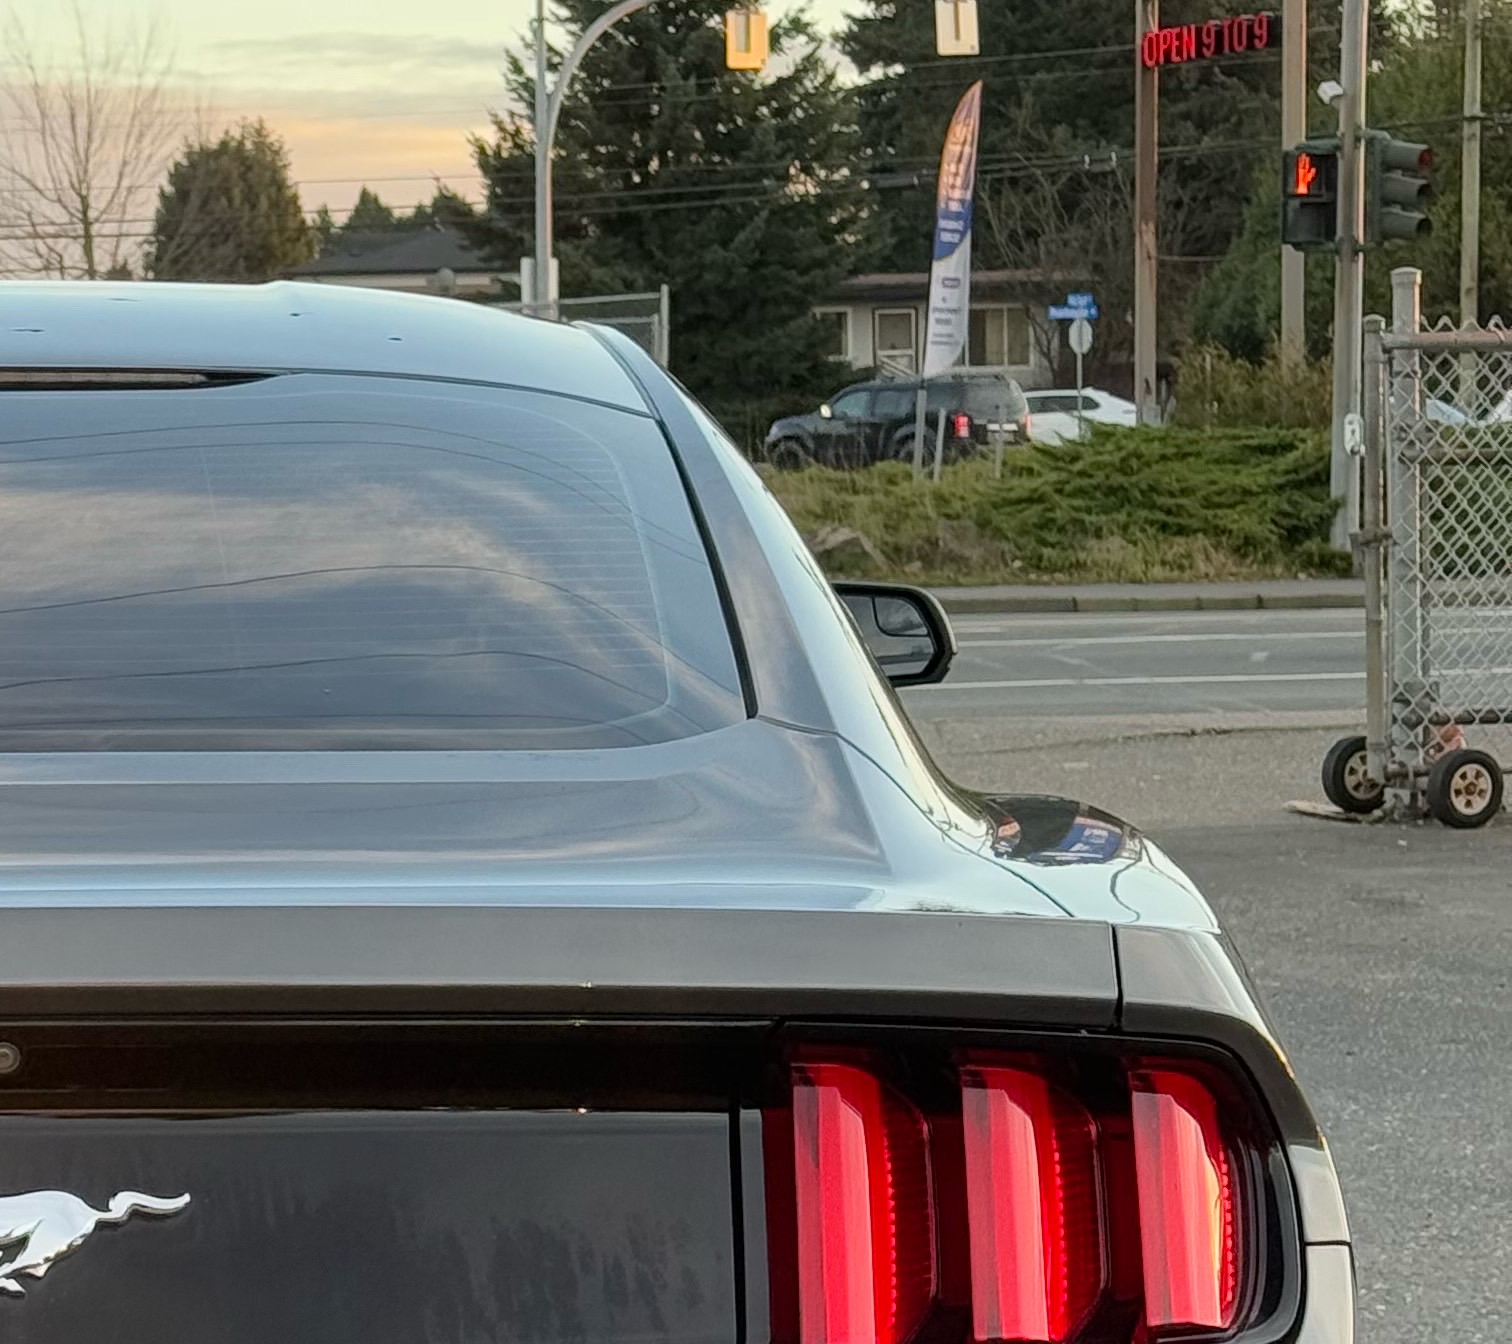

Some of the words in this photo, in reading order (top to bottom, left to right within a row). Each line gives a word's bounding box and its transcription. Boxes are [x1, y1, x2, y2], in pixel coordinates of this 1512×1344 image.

[1143, 23, 1196, 68] OPEN
[1202, 21, 1216, 58] 9
[1223, 15, 1248, 54] TO
[1253, 11, 1268, 49] 9
